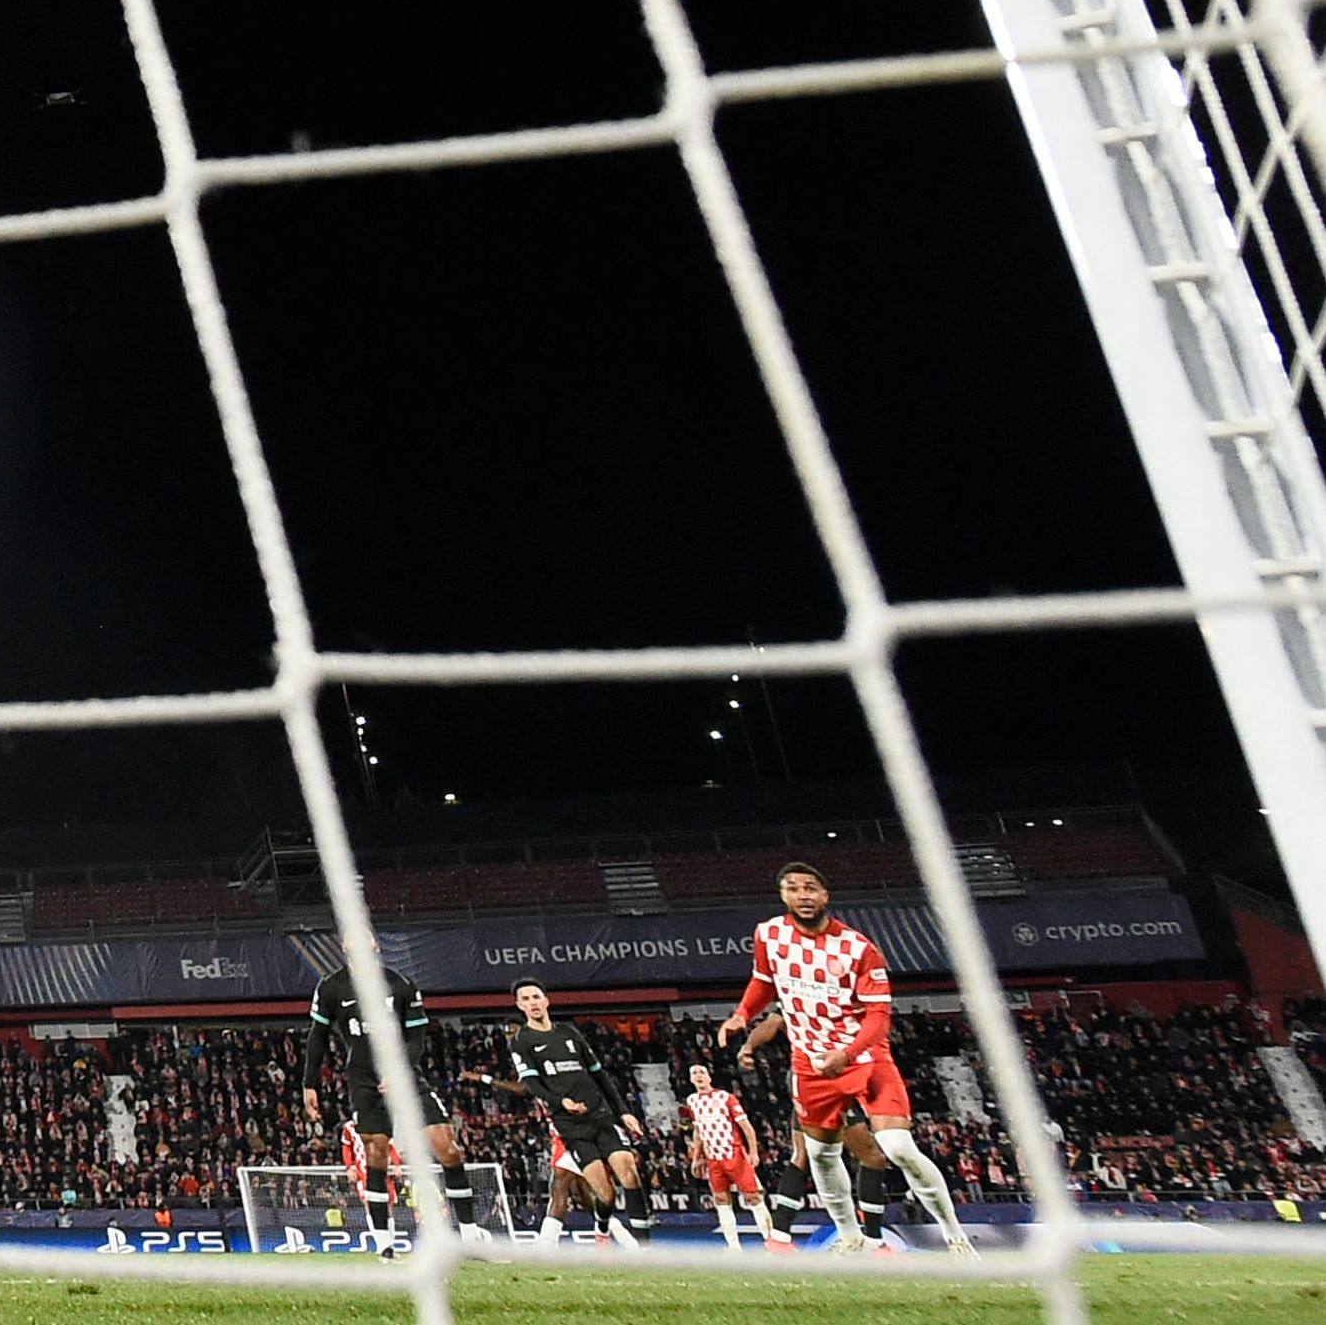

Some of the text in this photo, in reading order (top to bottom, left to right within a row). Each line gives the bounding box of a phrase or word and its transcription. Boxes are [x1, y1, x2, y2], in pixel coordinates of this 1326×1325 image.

[1045, 920, 1184, 942] crypto.com
[484, 935, 755, 966] UEFA CHAMPIONS LEAG
[180, 957, 248, 980] FedEx
[140, 1230, 225, 1253] PS5
